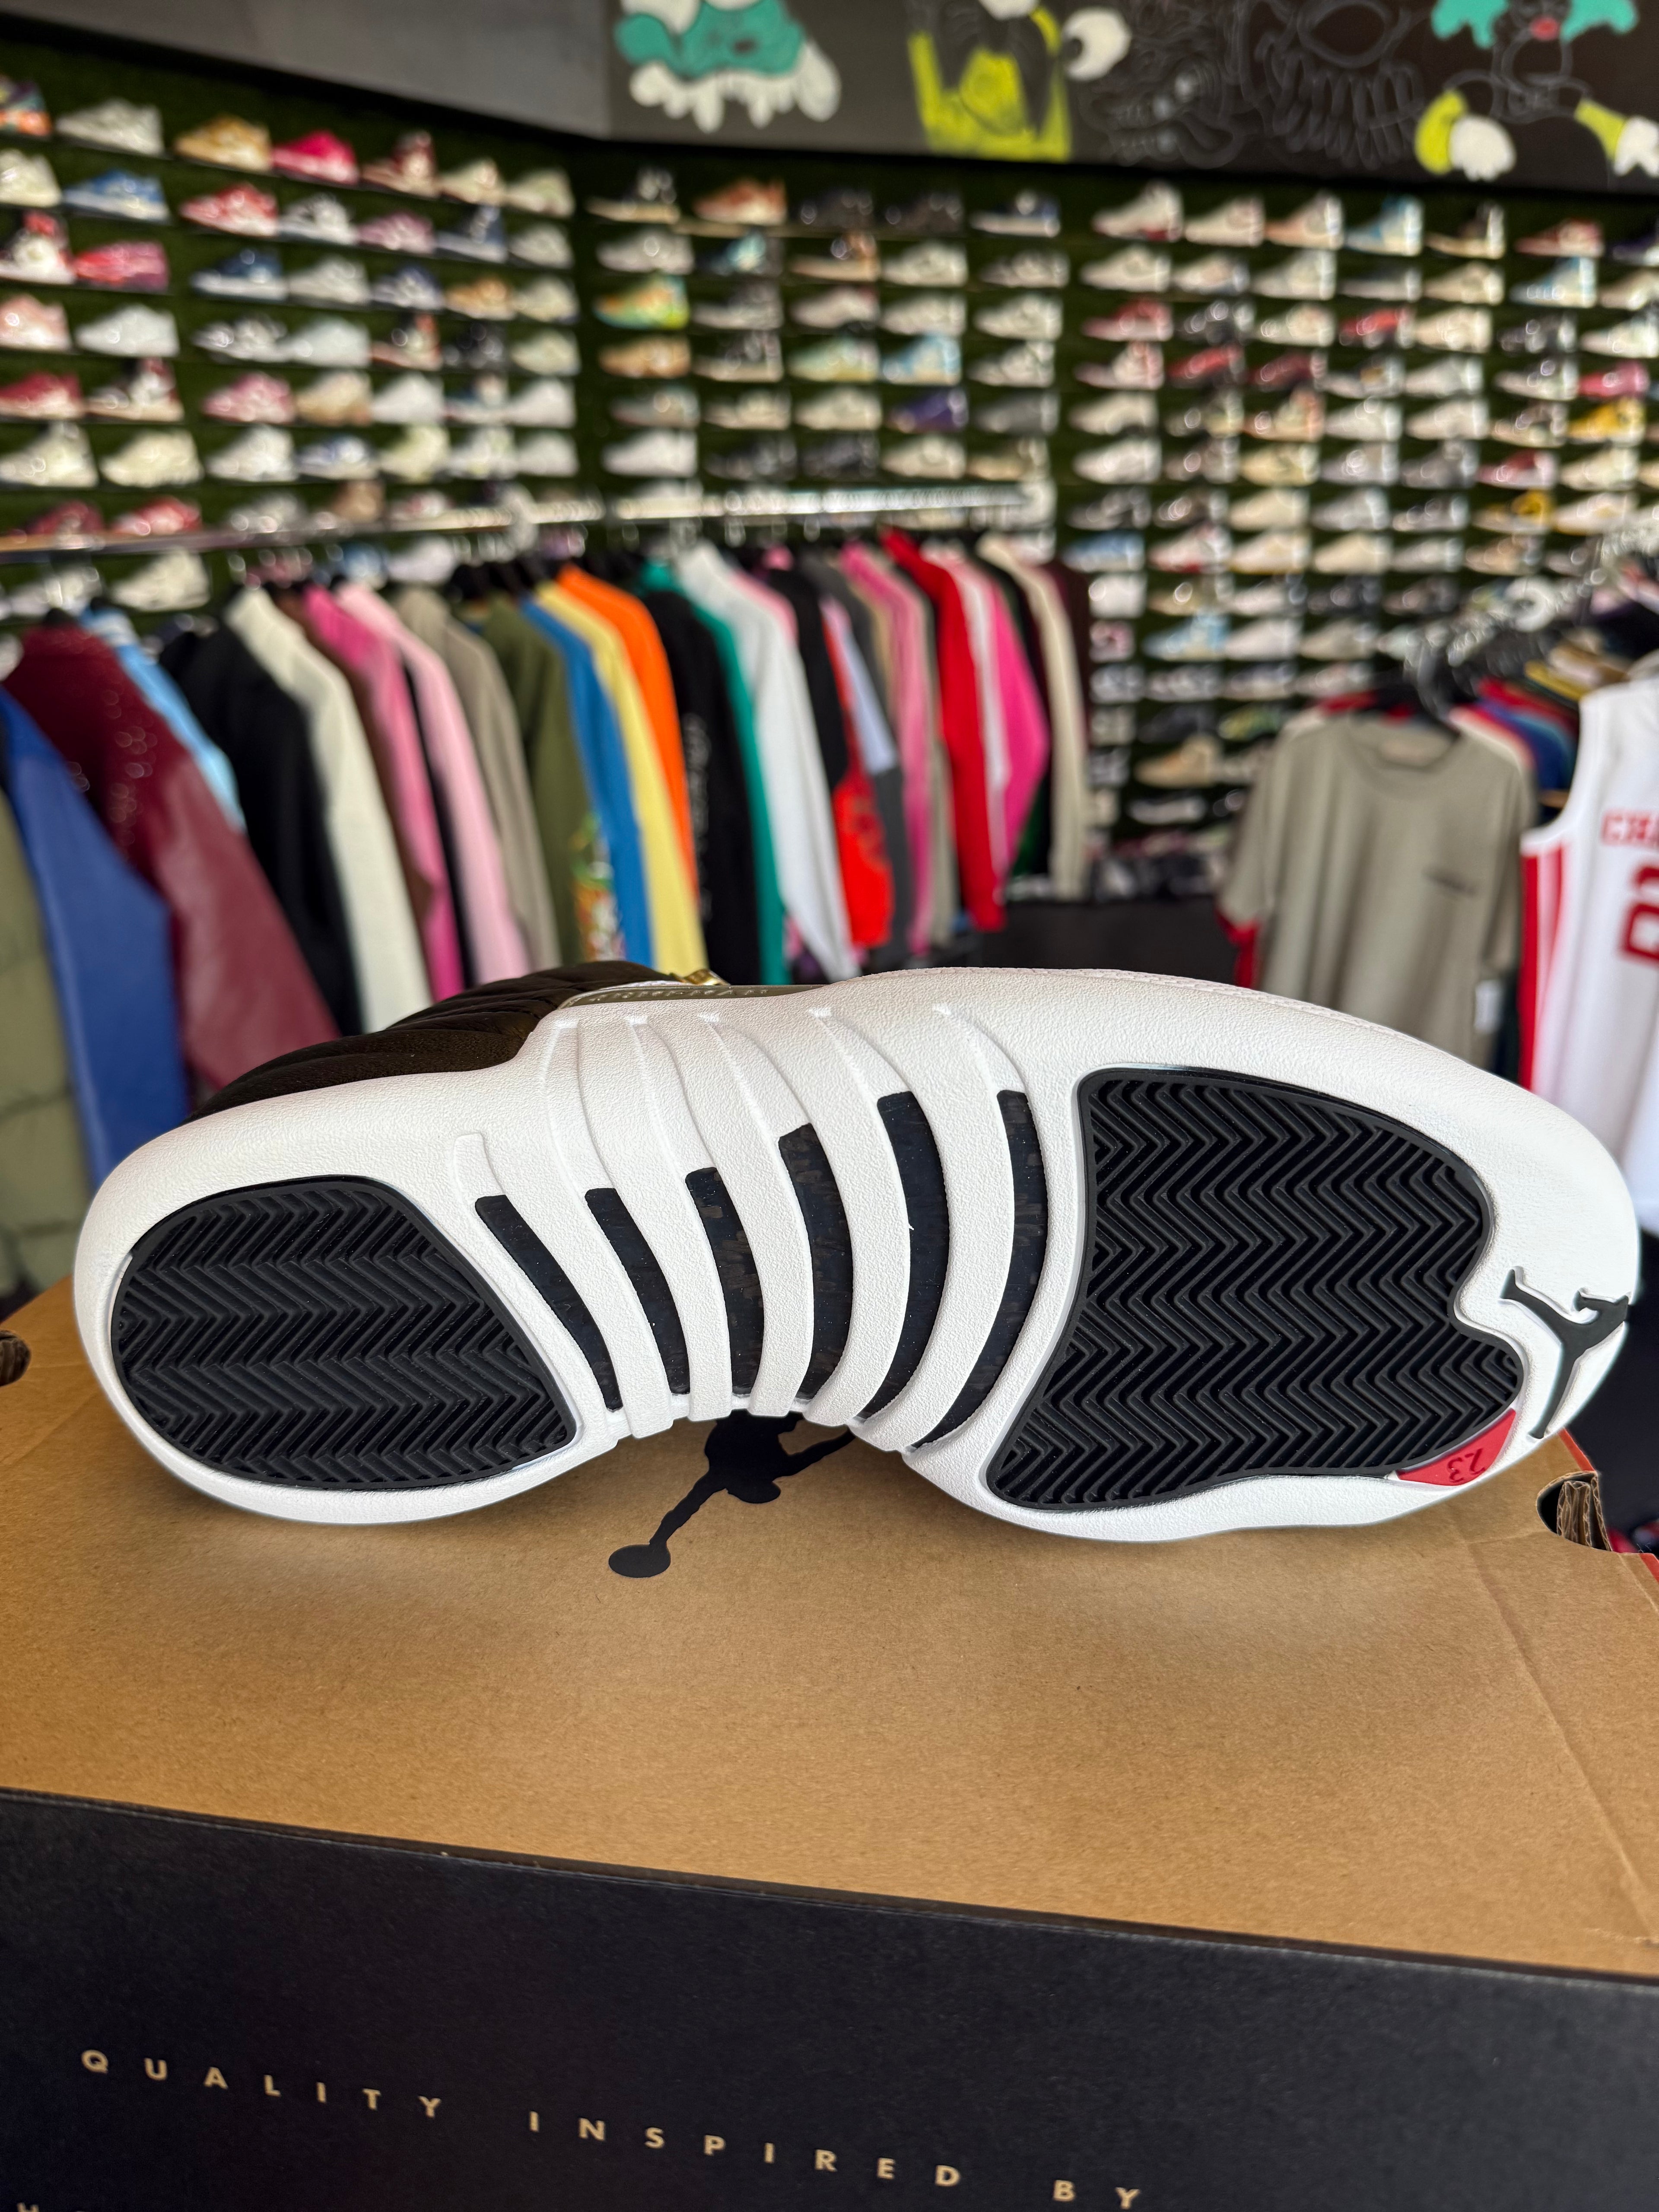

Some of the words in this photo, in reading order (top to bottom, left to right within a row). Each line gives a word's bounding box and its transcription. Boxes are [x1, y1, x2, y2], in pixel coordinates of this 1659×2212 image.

[1447, 1448, 1486, 1483] 23
[81, 2049, 441, 2119] QUALITY
[529, 2110, 961, 2188] INSPIRED
[1052, 2178, 1141, 2210] BY
